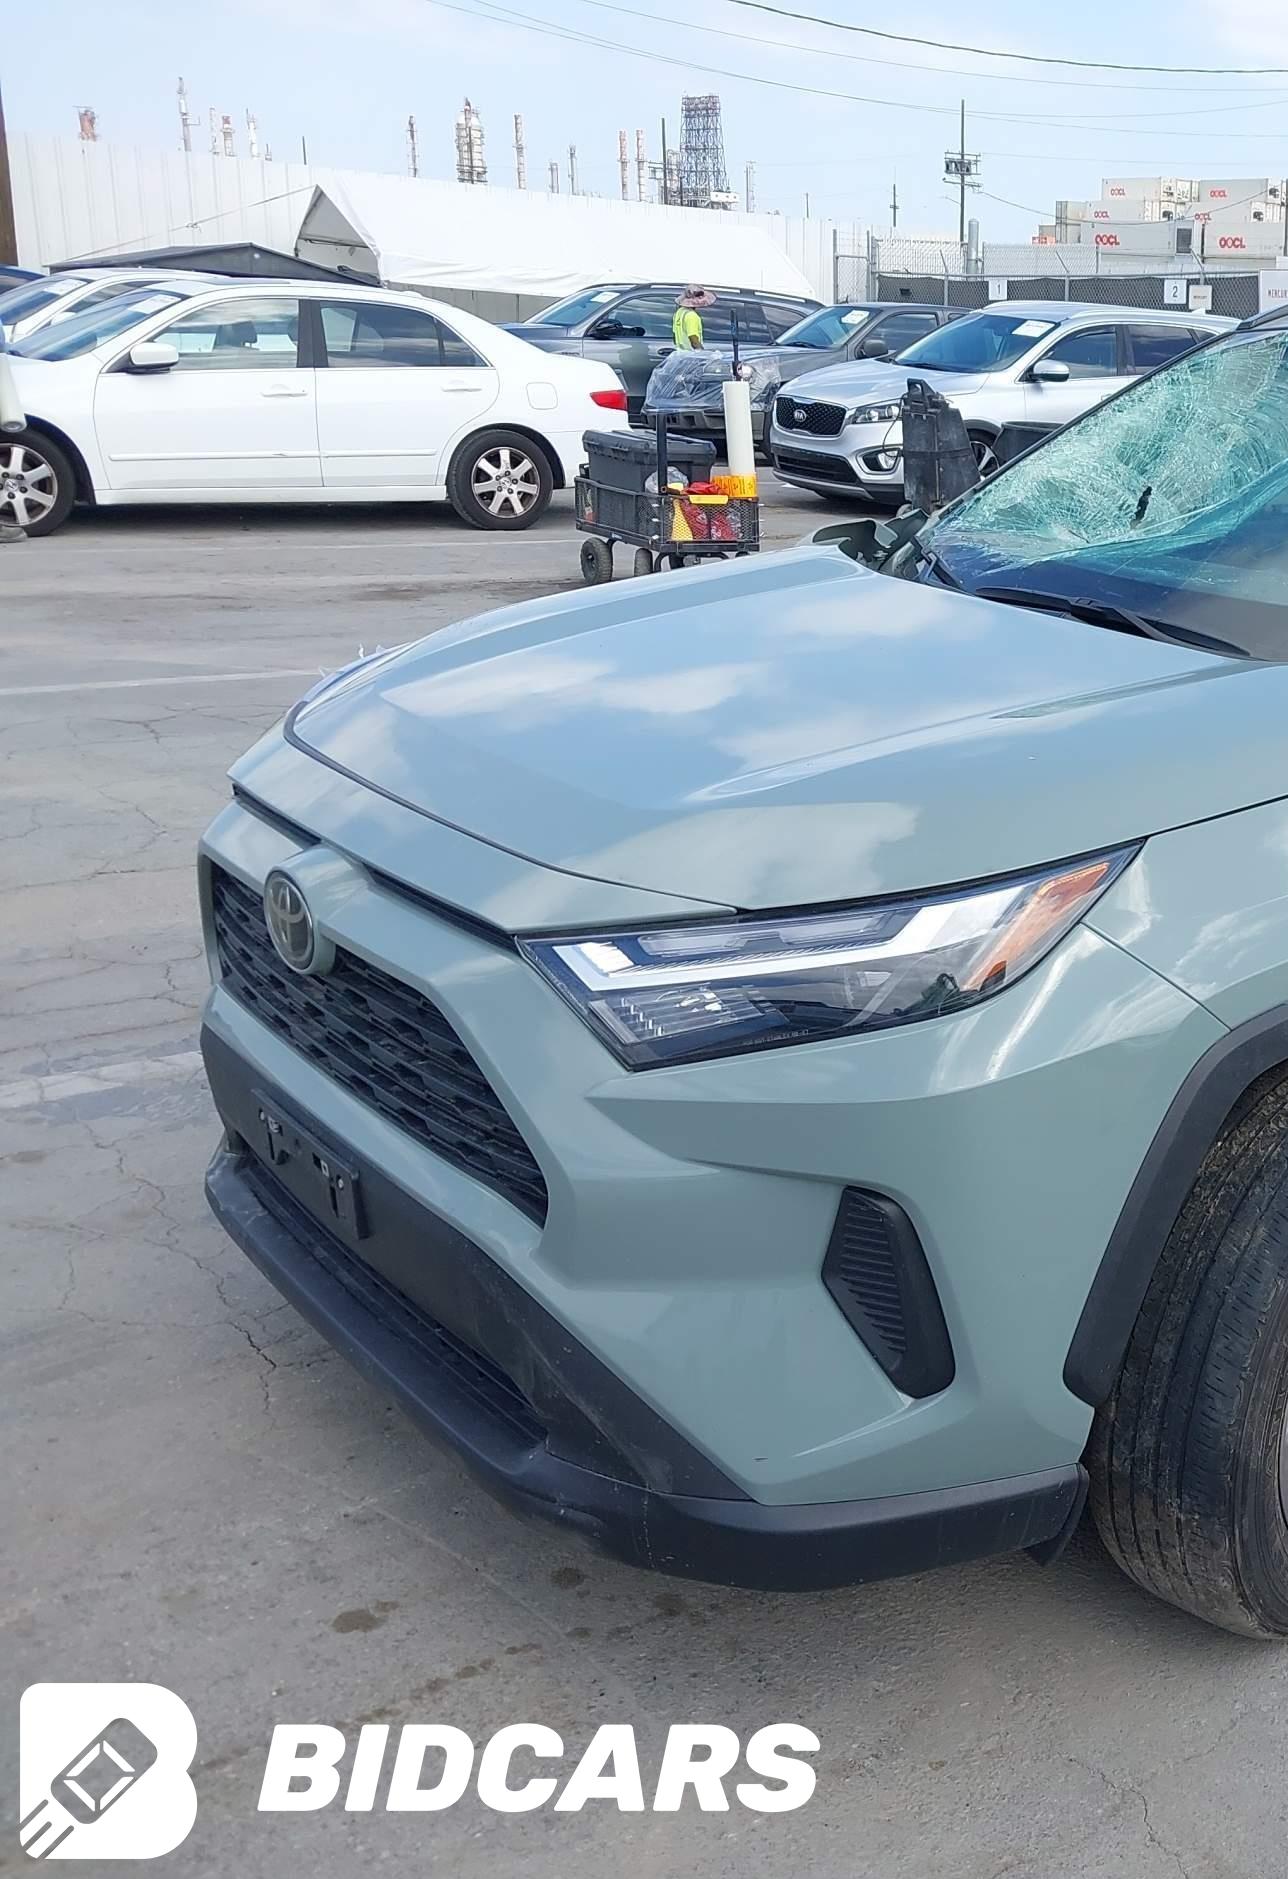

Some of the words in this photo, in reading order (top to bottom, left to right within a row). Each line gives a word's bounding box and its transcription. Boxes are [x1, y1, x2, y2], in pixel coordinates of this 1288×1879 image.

[1095, 234, 1120, 246] OOCL
[1219, 237, 1246, 249] OOCL
[1172, 285, 1178, 298] 2
